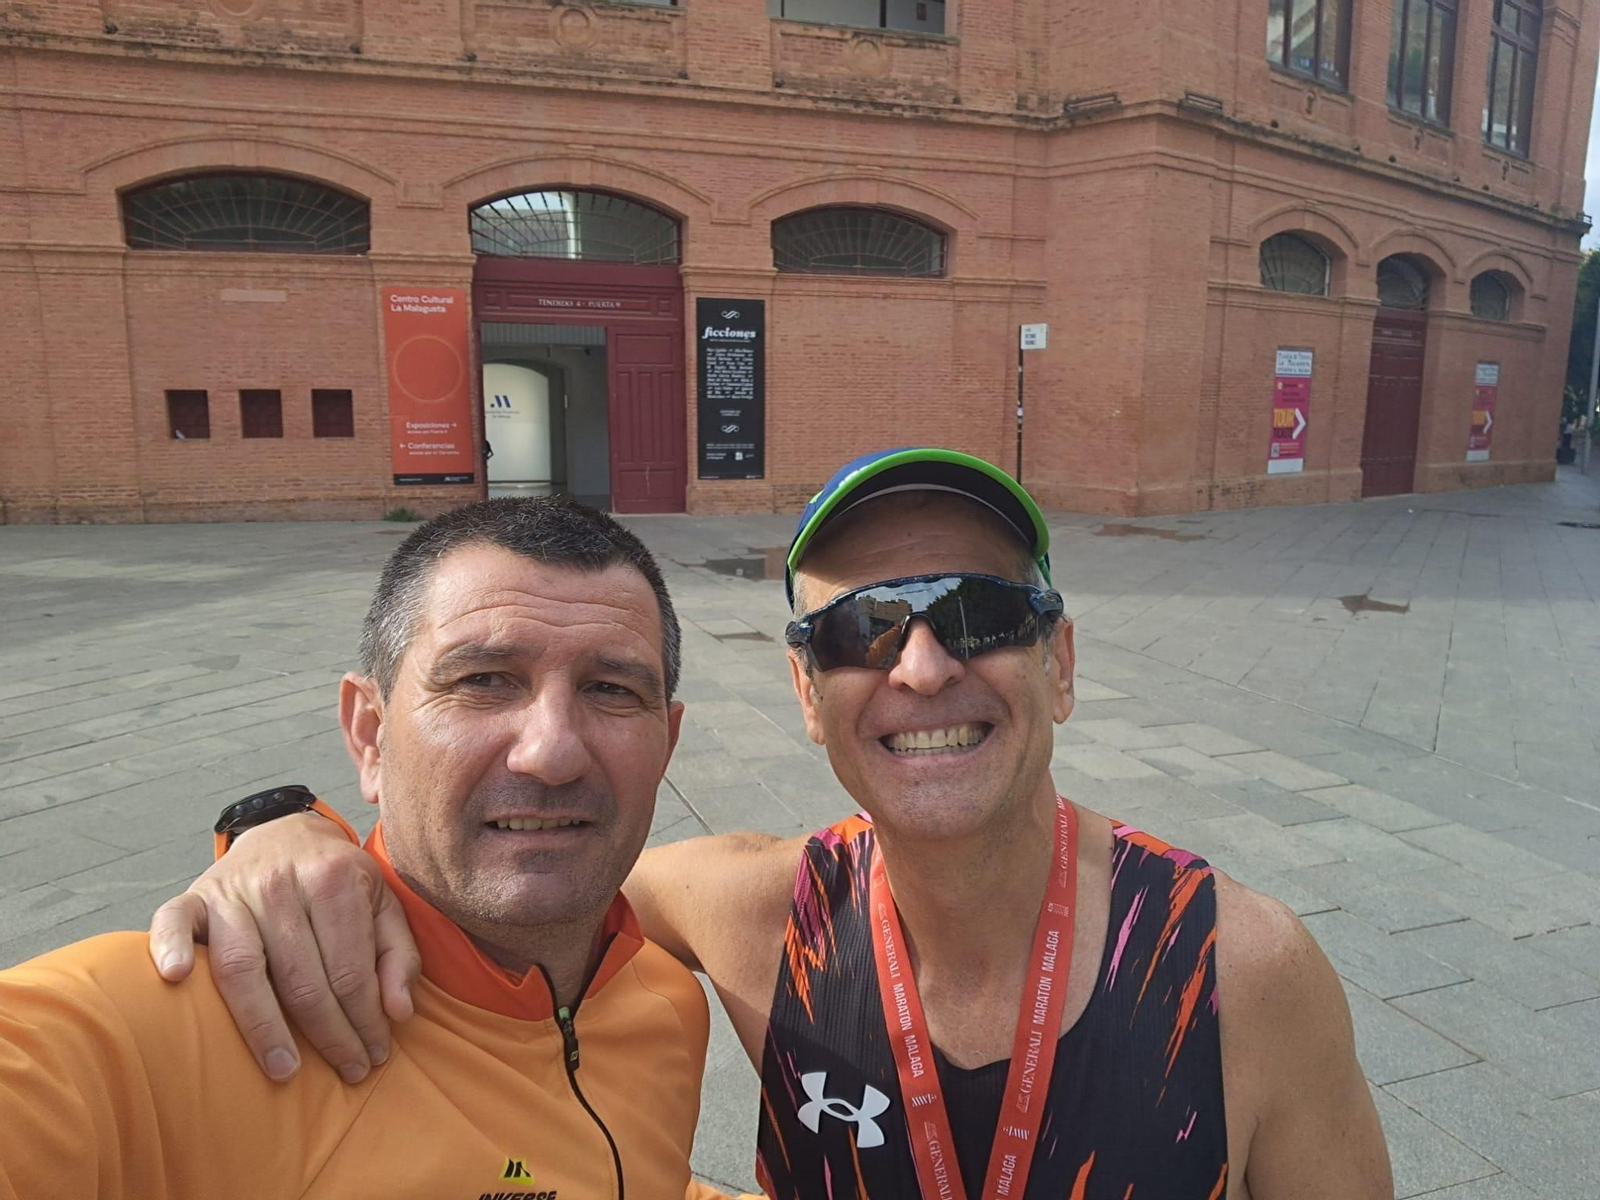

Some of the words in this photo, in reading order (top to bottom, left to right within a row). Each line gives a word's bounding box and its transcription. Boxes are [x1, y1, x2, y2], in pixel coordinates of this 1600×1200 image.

[390, 294, 420, 303] Centro
[421, 295, 454, 304] Cultural
[538, 299, 573, 307] TENDIDO
[391, 304, 402, 312] La
[403, 304, 446, 314] Malagueta
[701, 326, 756, 340] ficciones
[1273, 408, 1294, 427] TOUR
[406, 422, 450, 430] Exposiciones
[407, 442, 455, 450] Conferencias
[1060, 814, 1068, 869] GENERALI
[1042, 930, 1060, 972] MÁLAGA
[882, 919, 900, 978] GENERALI
[893, 983, 912, 1031] MARATÓN
[1033, 976, 1053, 1025] MARATÓN
[1020, 1031, 1042, 1094] GENERALI
